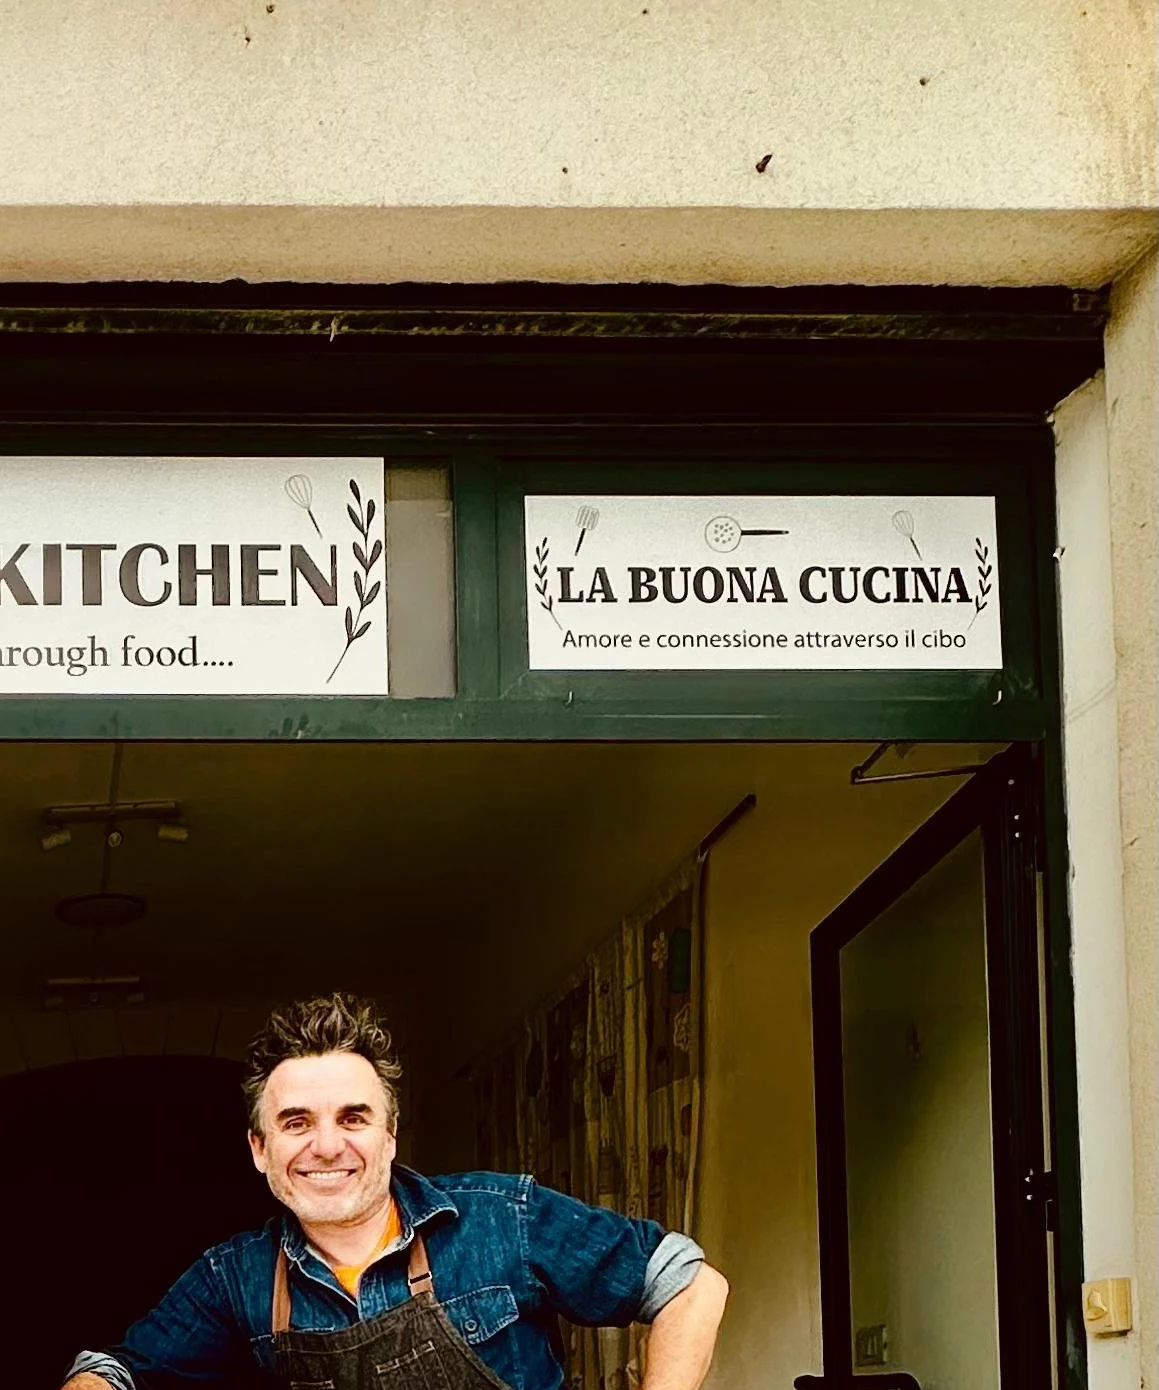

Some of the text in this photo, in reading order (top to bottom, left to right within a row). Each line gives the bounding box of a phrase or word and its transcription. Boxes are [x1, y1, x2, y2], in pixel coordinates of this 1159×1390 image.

[557, 566, 973, 604] LA BUONA CUCINA
[562, 629, 967, 648] Amore e connessione attraverso il cibo
